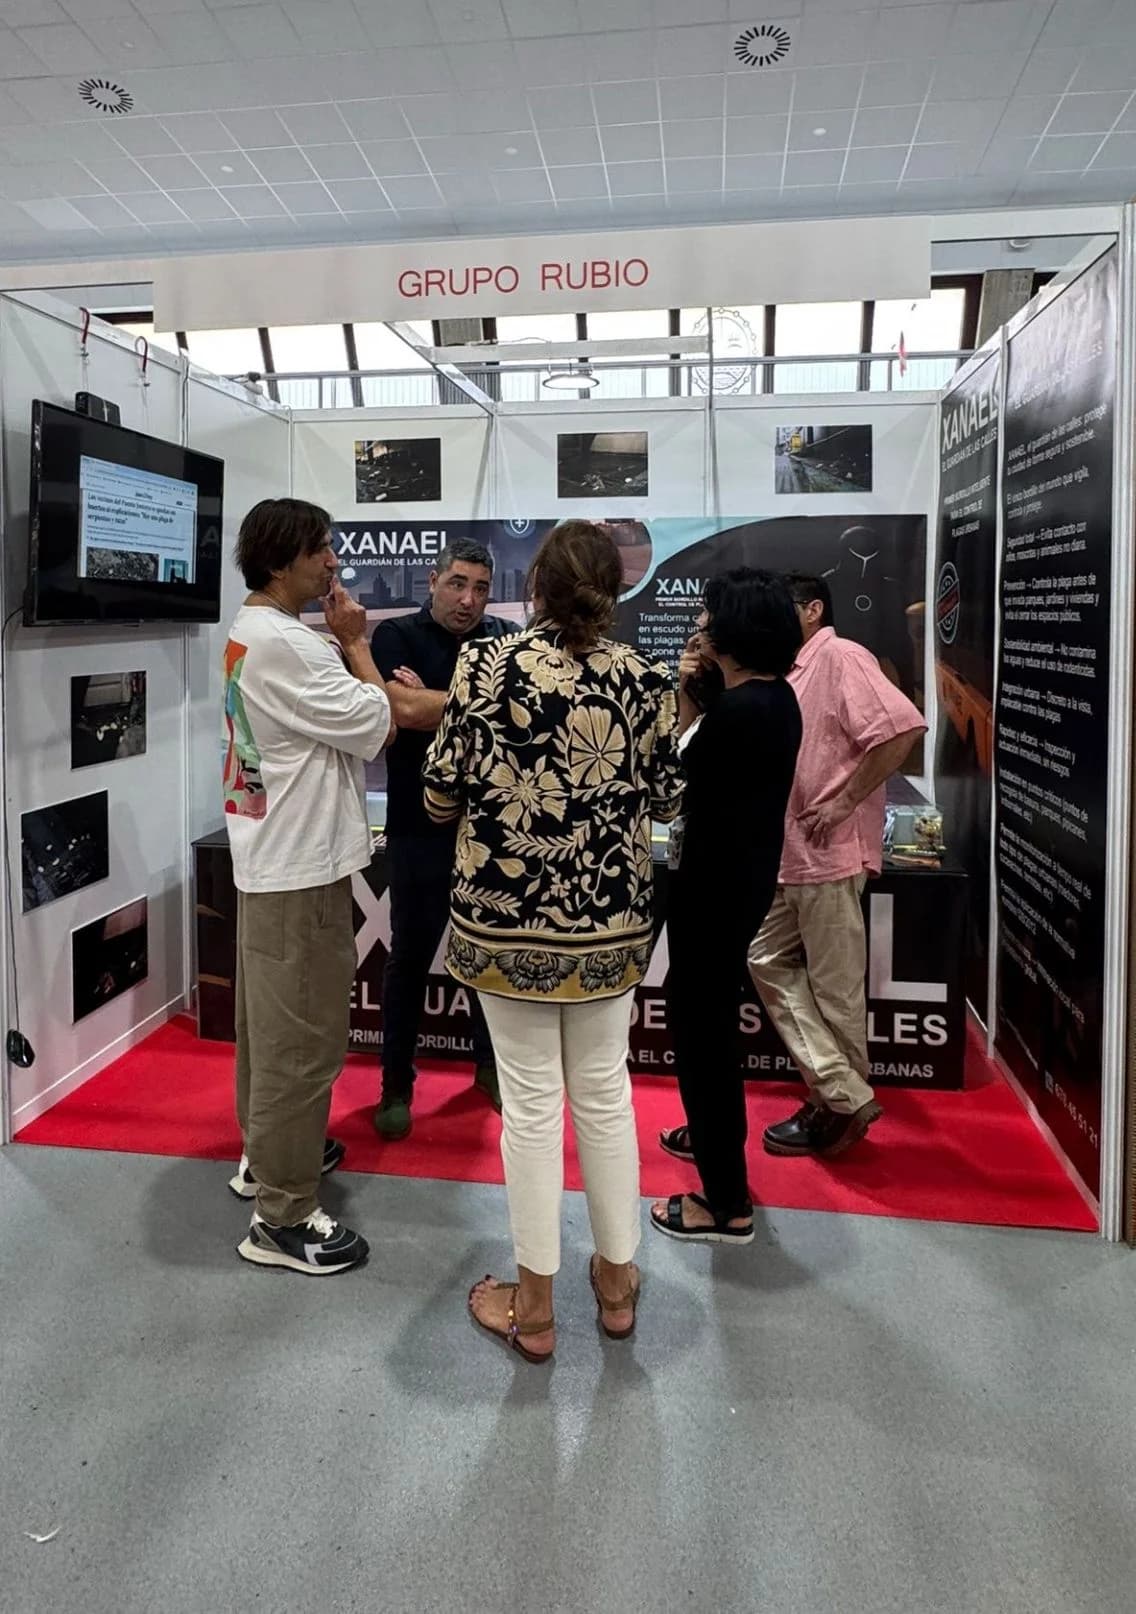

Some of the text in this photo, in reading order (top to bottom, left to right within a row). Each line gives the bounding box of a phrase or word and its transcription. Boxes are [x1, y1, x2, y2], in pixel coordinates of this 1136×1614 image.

[398, 258, 649, 298] GRUPO RUBIO
[942, 386, 998, 455] XANAEL
[1062, 473, 1073, 486] que
[349, 557, 392, 566] GUARDIÁN
[1087, 573, 1096, 585] de
[639, 612, 690, 622] Transforma
[652, 625, 686, 633] escudo
[638, 635, 652, 644] las
[867, 1011, 948, 1046] LES
[417, 1034, 474, 1051] ORDILL
[639, 1050, 659, 1063] EL
[748, 1055, 771, 1069] DE
[1089, 1126, 1098, 1150] 21
